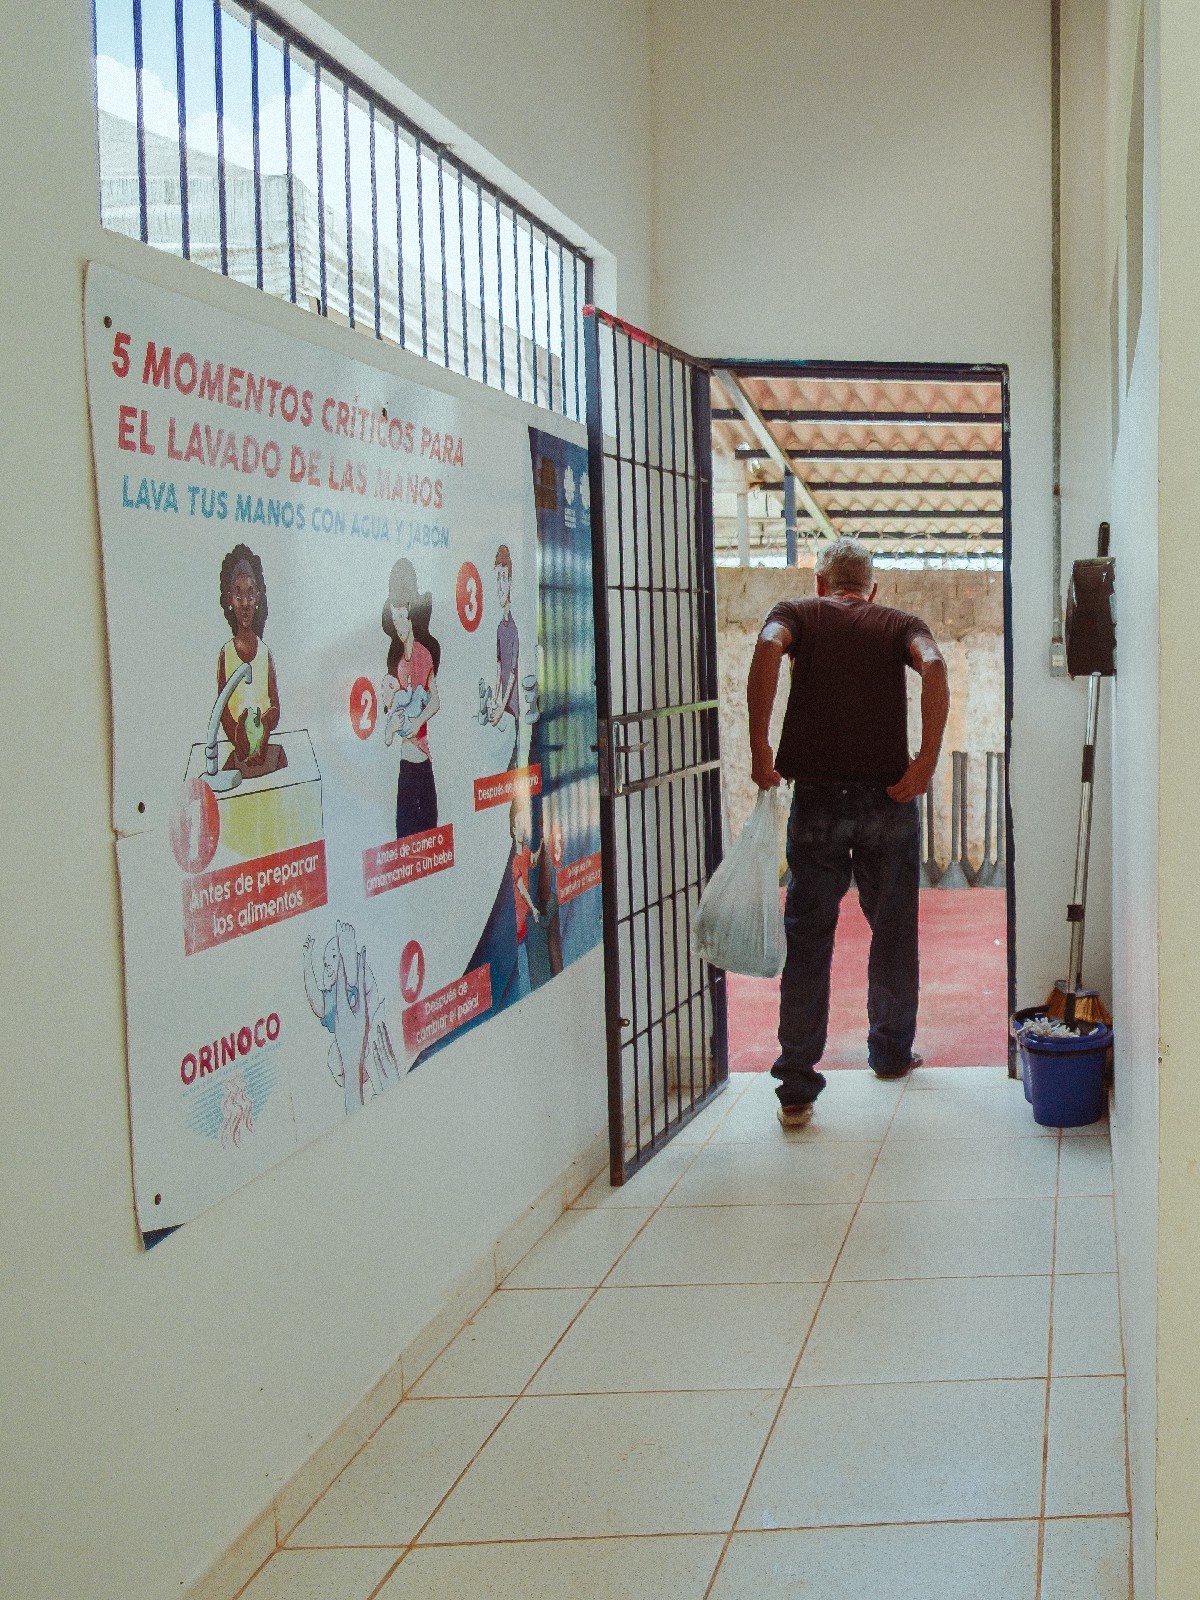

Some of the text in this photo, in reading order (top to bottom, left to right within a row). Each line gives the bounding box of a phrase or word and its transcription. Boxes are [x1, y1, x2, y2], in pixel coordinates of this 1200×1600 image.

[112, 331, 464, 467] 5 MOMENTOS CRÍTICOS PARA
[118, 404, 444, 509] EL LAVADO DE LAS MANOS
[122, 474, 179, 514] LAVA
[187, 485, 229, 520] TUS
[235, 493, 306, 530] MANOS
[311, 506, 346, 534] CON
[350, 513, 390, 541] AGUA
[465, 577, 477, 621] 3
[359, 690, 372, 729] 2
[187, 800, 201, 859] 1
[400, 841, 410, 857] de
[412, 835, 436, 853] comer
[437, 834, 443, 845] o
[189, 855, 319, 911] Antes de preparar
[423, 855, 433, 870] un
[213, 889, 303, 938] los alimentos
[405, 952, 420, 993] 4
[181, 1012, 281, 1085] ORINOCO
